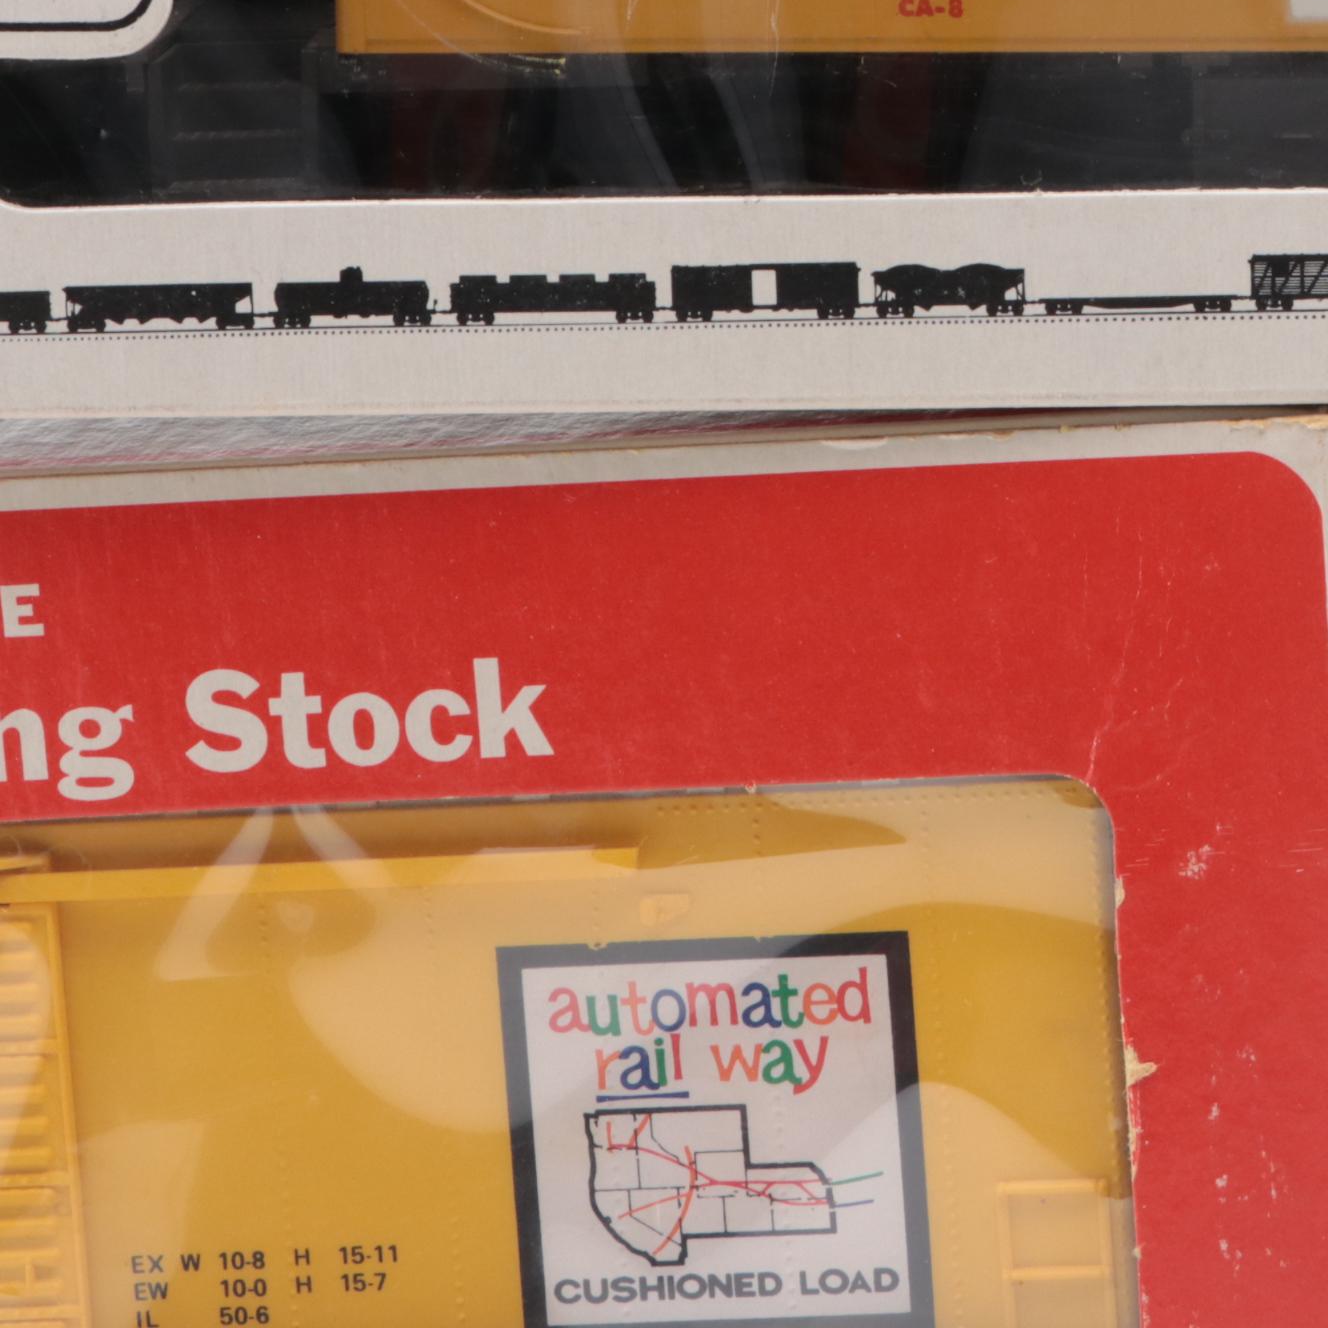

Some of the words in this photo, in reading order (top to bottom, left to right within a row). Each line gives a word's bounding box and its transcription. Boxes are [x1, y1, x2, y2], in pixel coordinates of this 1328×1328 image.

[185, 657, 555, 773] Stock
[547, 966, 872, 1036] automated
[595, 1033, 683, 1091] rail
[710, 1035, 829, 1095] way
[131, 1255, 164, 1273] EX
[180, 1253, 200, 1271] W
[219, 1251, 265, 1271] 10-8
[294, 1248, 310, 1266] H
[338, 1244, 399, 1264] 15-11
[134, 1282, 168, 1301] EW
[220, 1279, 267, 1298] 10-0
[296, 1275, 312, 1294] H
[341, 1272, 387, 1292] 15-7
[554, 1270, 784, 1304] CUSHIONED
[800, 1267, 900, 1296] LOAD
[136, 1310, 159, 1328] IL
[219, 1305, 269, 1325] 50-6
